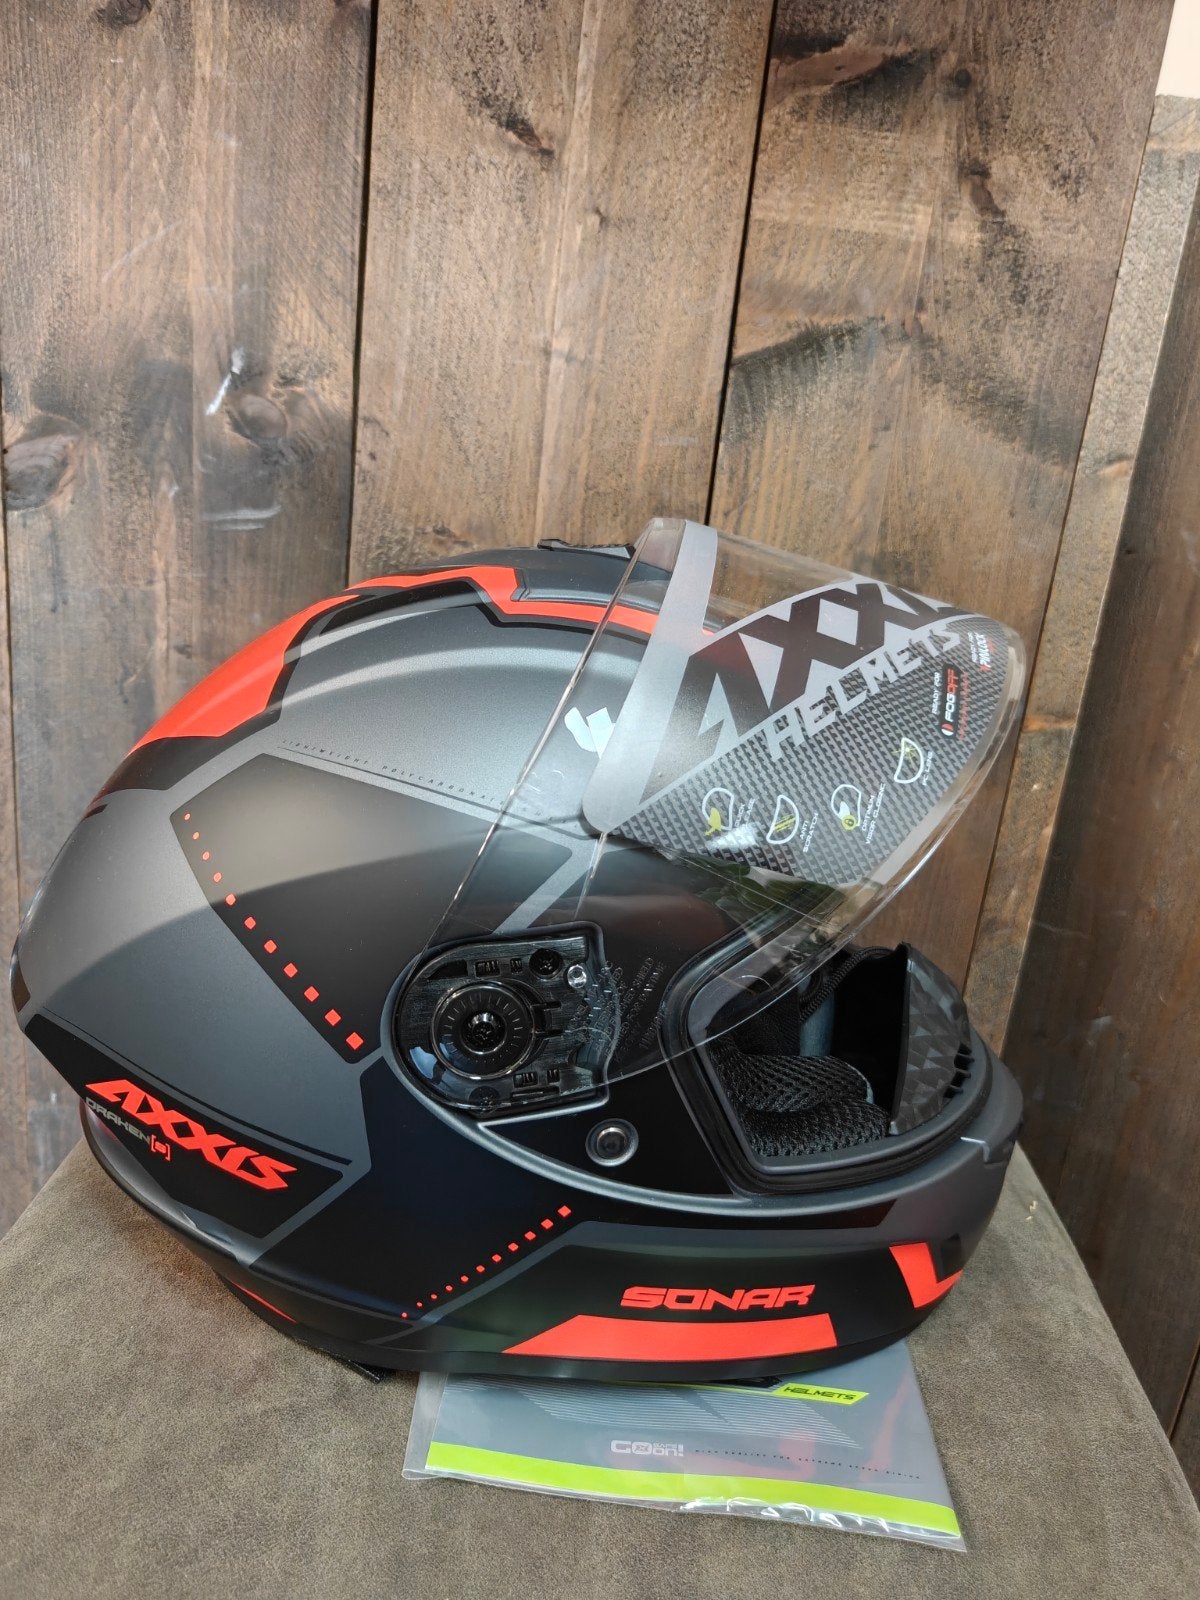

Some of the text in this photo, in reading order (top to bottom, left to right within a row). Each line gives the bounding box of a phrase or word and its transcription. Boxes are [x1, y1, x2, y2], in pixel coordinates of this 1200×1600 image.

[764, 622, 961, 761] HELMETS
[931, 671, 942, 715] READY FOR
[944, 667, 960, 723] FOGOFF
[800, 820, 810, 841] ANTI
[803, 812, 819, 854] SCRATCH
[866, 820, 877, 845] VISOR
[85, 1096, 151, 1145] DRAKEN
[85, 1079, 298, 1190] AXXIS
[620, 1284, 816, 1311] SONAR
[784, 1386, 857, 1401] HELMETS
